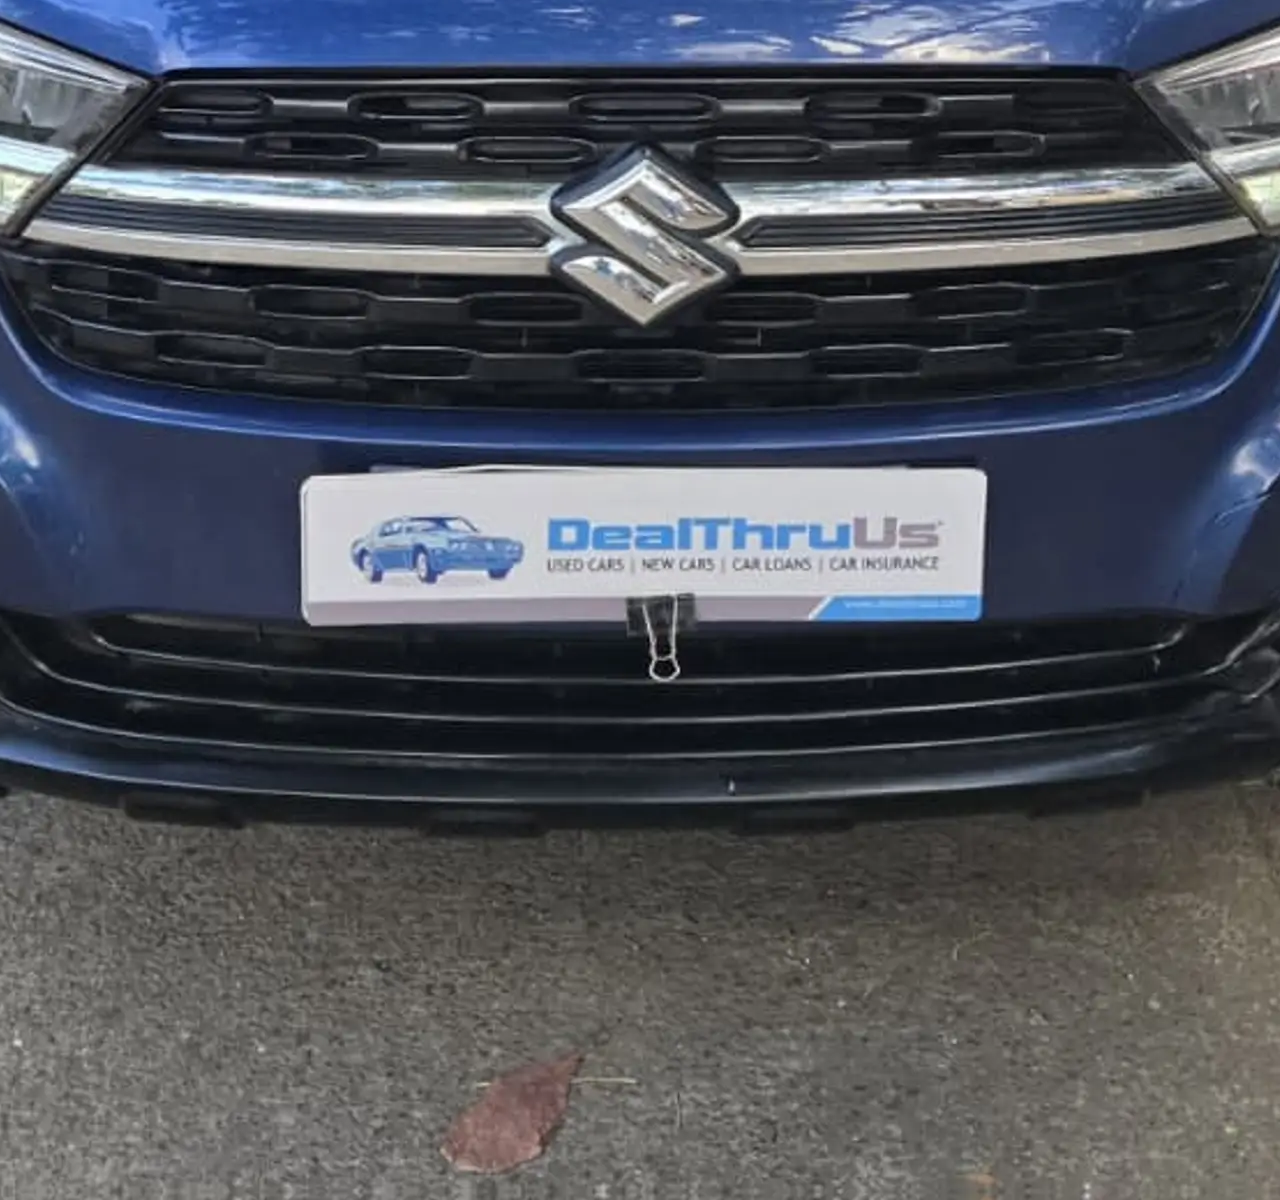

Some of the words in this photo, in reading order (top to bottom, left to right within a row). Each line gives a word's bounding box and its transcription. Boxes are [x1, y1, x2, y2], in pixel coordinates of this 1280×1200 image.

[548, 517, 940, 551] DealThruUs
[547, 558, 584, 573] USED
[587, 558, 625, 573] CARS
[642, 558, 673, 572] NEW
[679, 558, 716, 572] CARS
[732, 557, 761, 572] CAR
[765, 557, 812, 572] LOANS
[829, 557, 857, 572] CAR
[861, 556, 939, 571] INSURANCE
